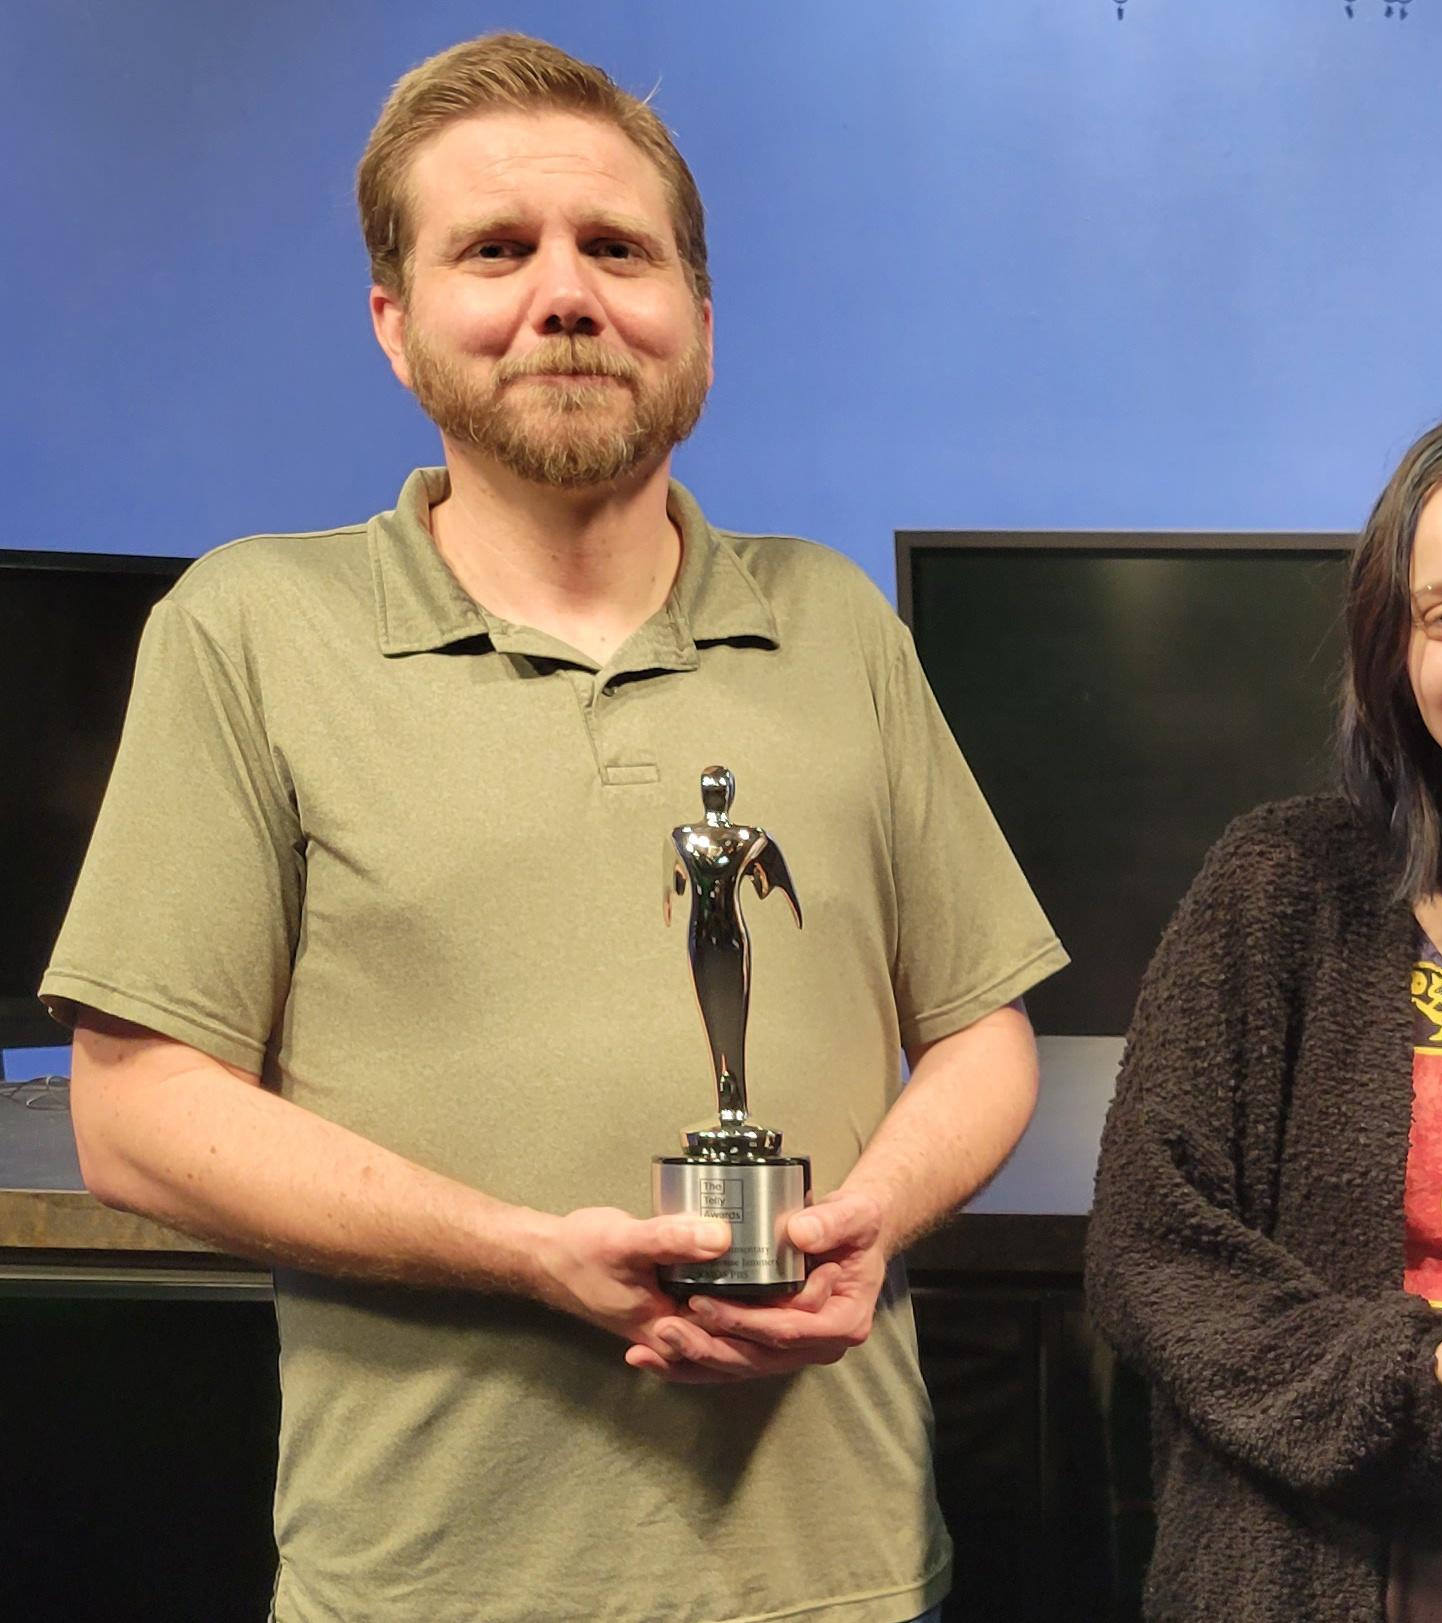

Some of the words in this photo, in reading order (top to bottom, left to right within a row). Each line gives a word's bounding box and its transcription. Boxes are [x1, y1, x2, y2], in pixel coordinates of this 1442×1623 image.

[703, 1181, 723, 1192] The
[703, 1195, 726, 1207] Telly
[703, 1209, 741, 1220] Awards
